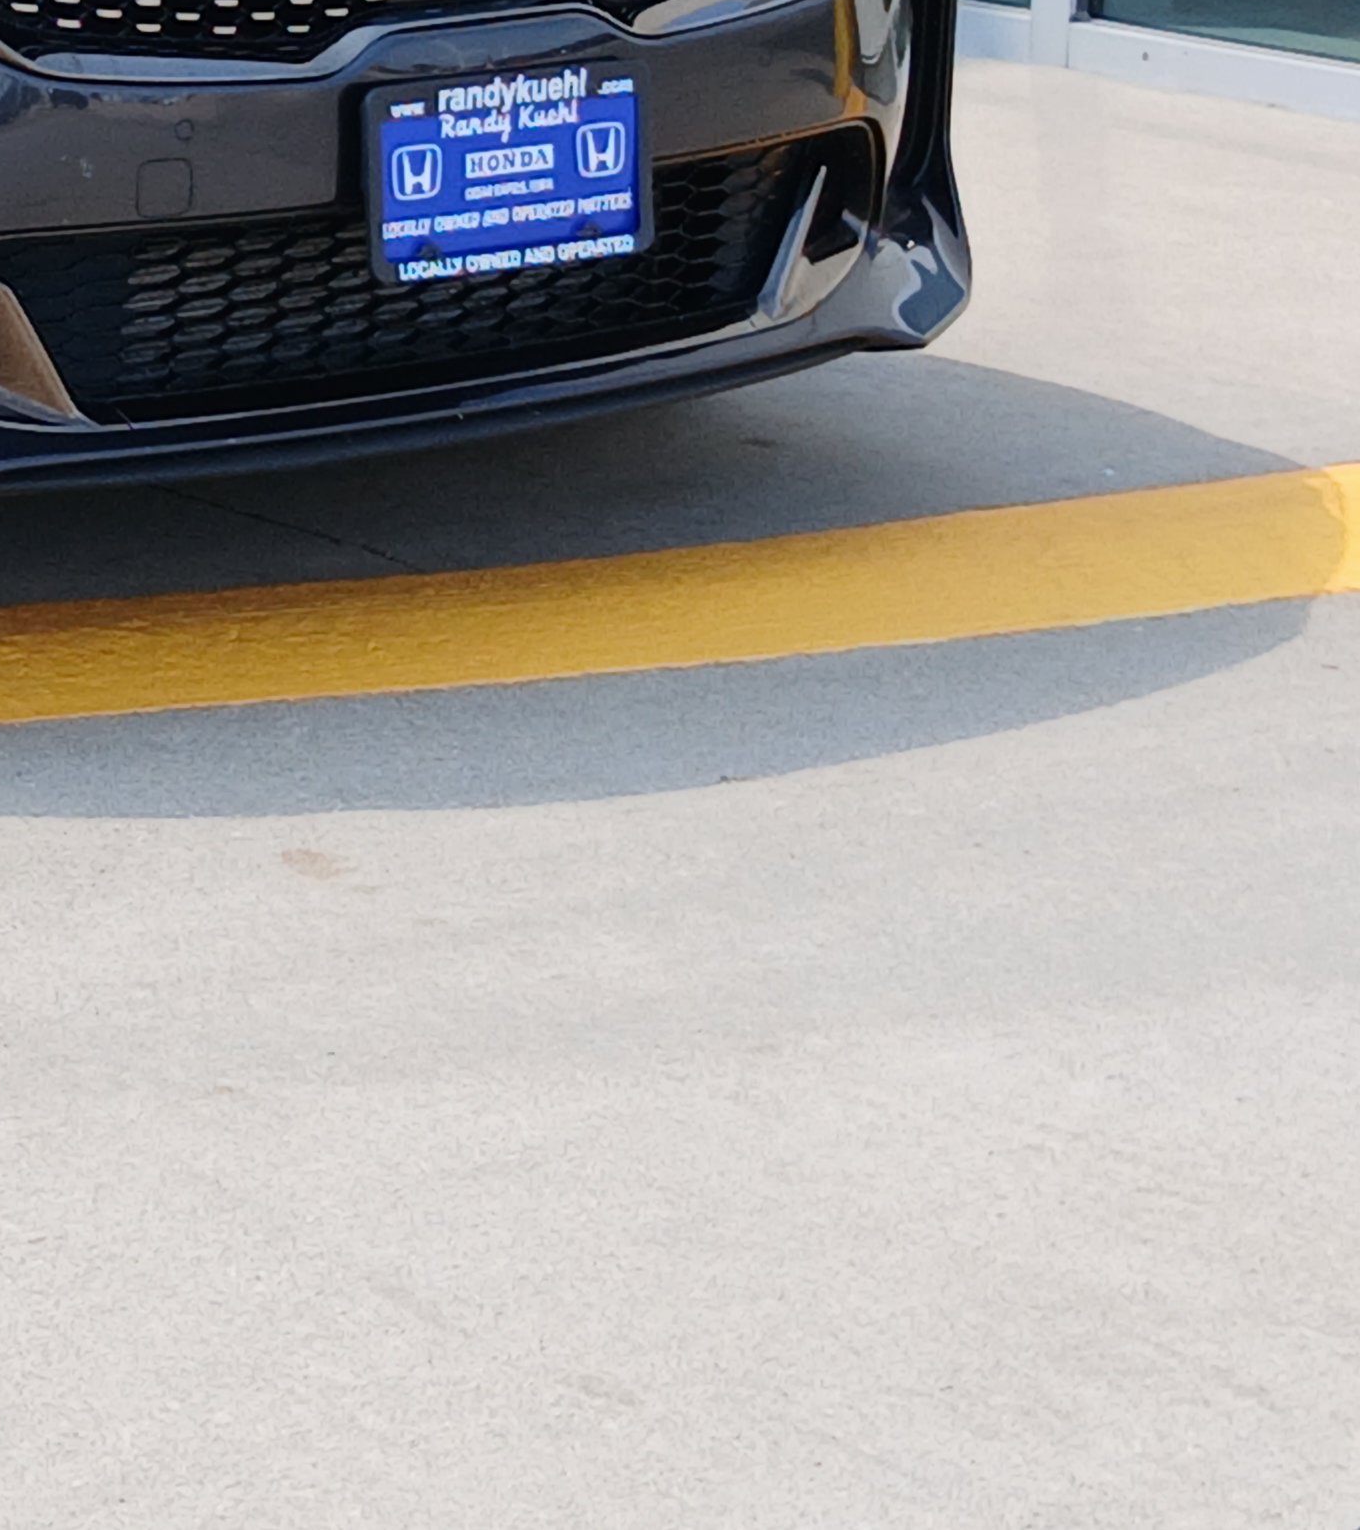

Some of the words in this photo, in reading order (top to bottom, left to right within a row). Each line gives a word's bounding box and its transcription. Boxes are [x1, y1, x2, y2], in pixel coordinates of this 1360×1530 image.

[438, 67, 588, 113] randykuehl
[438, 110, 511, 144] Randy
[518, 99, 578, 130] Kuehl
[470, 148, 550, 173] HONDA
[399, 256, 463, 281] LOCALLY
[466, 249, 522, 273] OWNED
[524, 244, 555, 265] AND
[557, 234, 635, 261] OPERATED
